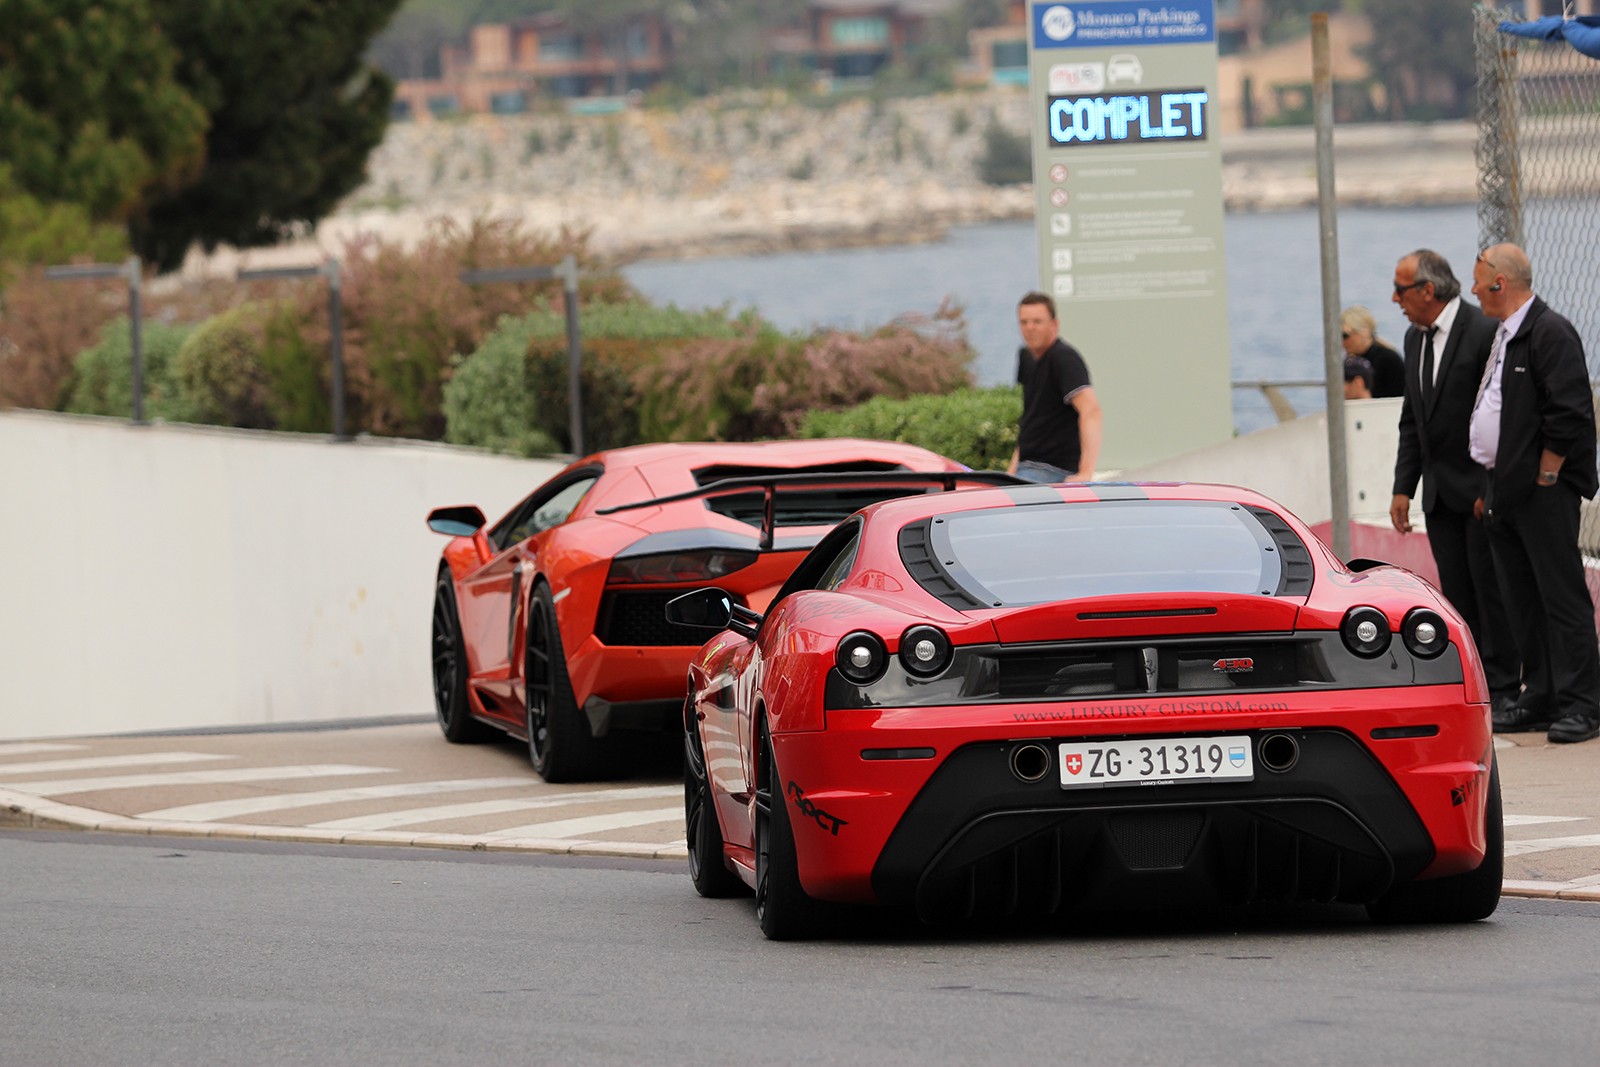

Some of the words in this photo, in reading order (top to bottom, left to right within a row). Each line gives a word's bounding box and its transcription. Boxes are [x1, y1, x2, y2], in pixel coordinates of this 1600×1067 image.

[1077, 10, 1136, 26] Monaco
[1050, 92, 1208, 142] COMPLET
[1213, 657, 1254, 669] 430
[1013, 700, 1289, 722] www.LUXURY-CUSTOM.com
